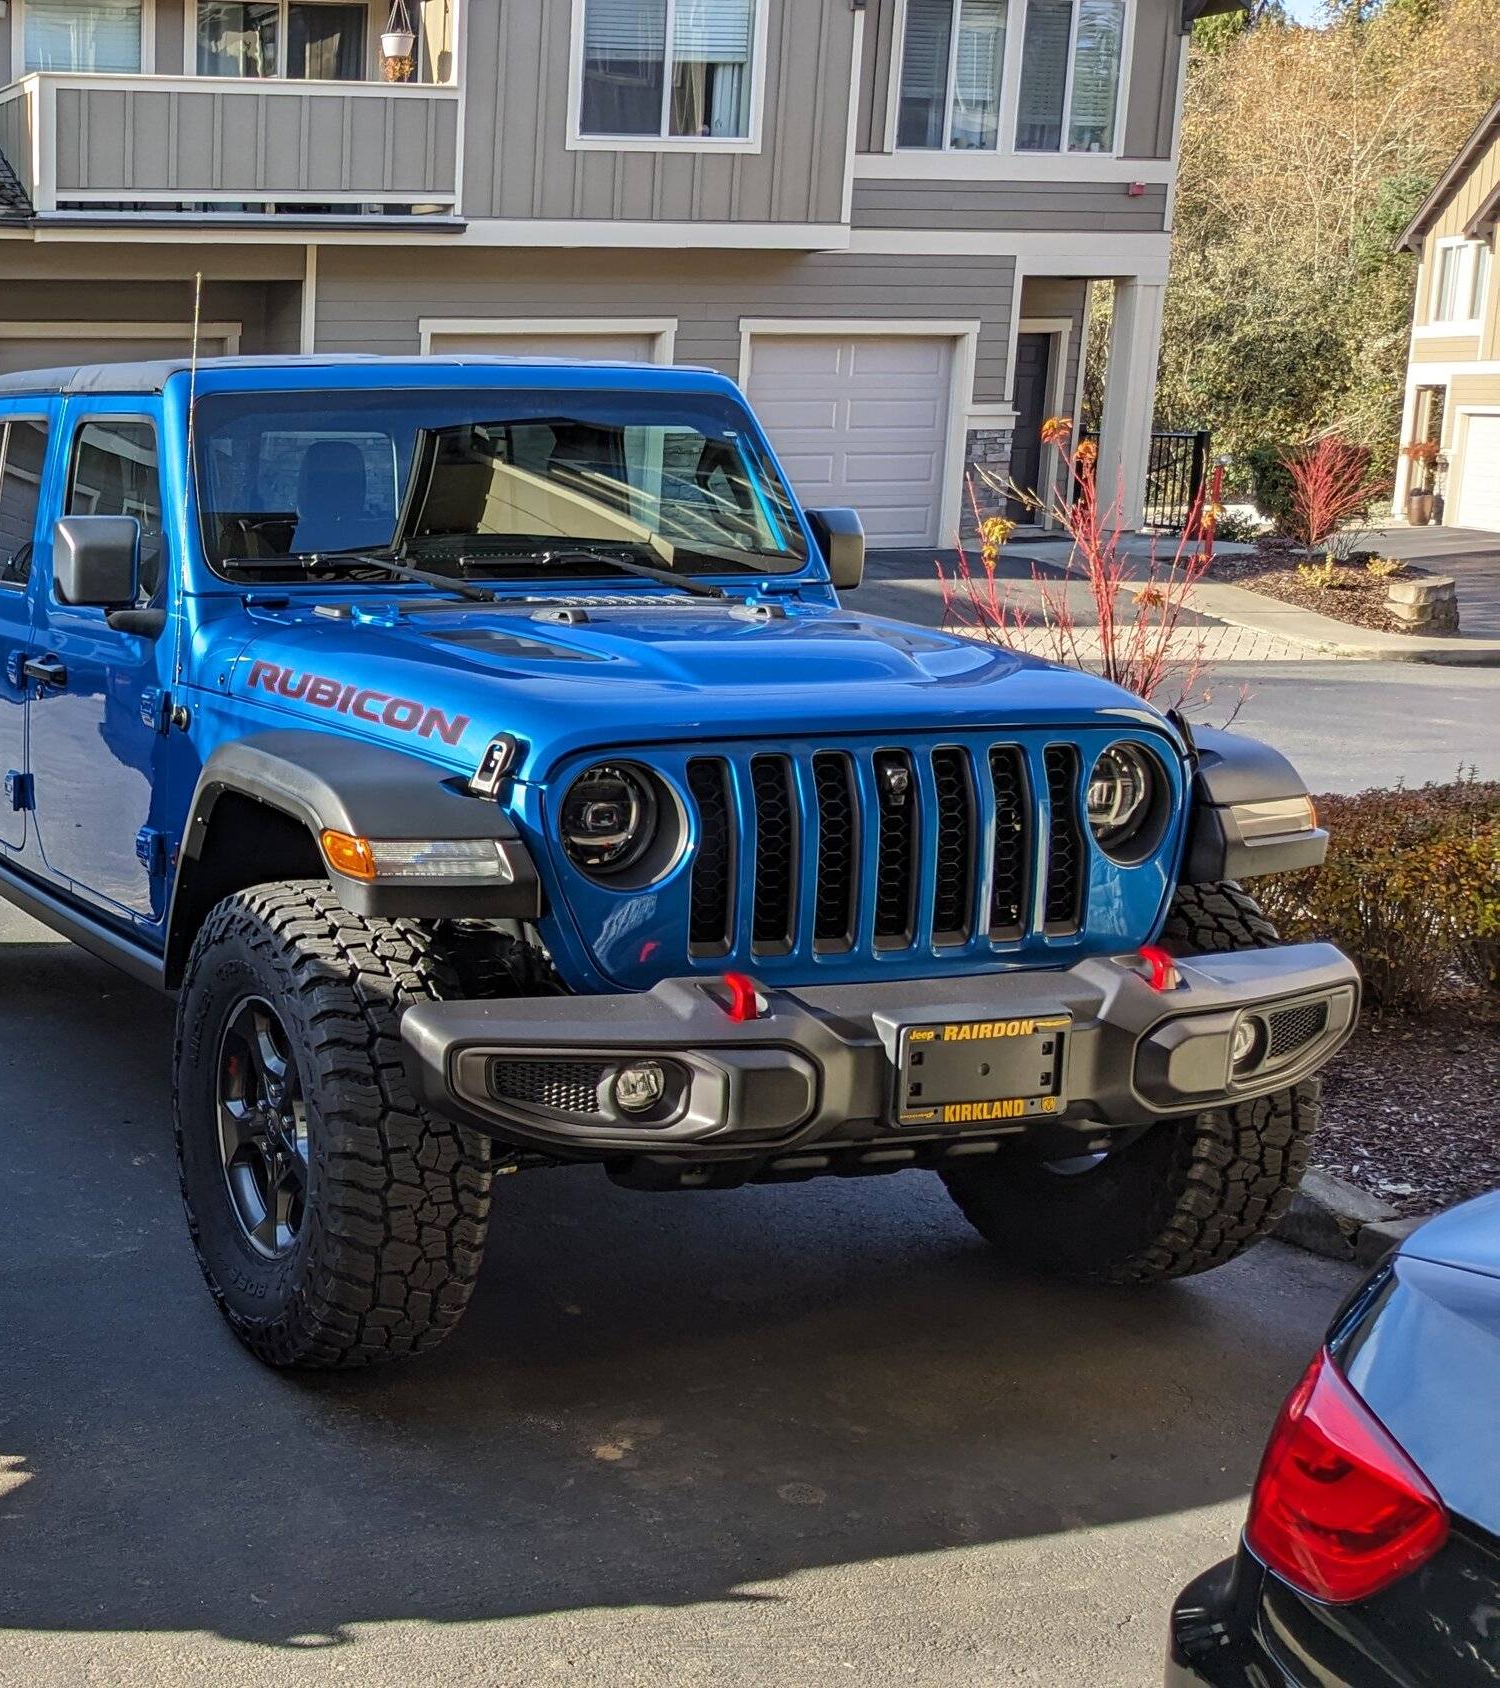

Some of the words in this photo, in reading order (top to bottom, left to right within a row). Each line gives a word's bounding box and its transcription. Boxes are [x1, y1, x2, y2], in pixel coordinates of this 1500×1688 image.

[247, 660, 471, 746] RUBICON
[909, 1031, 935, 1040] Jeep
[943, 1020, 1034, 1041] RAIRDON
[944, 1100, 1026, 1122] KIRKLAND
